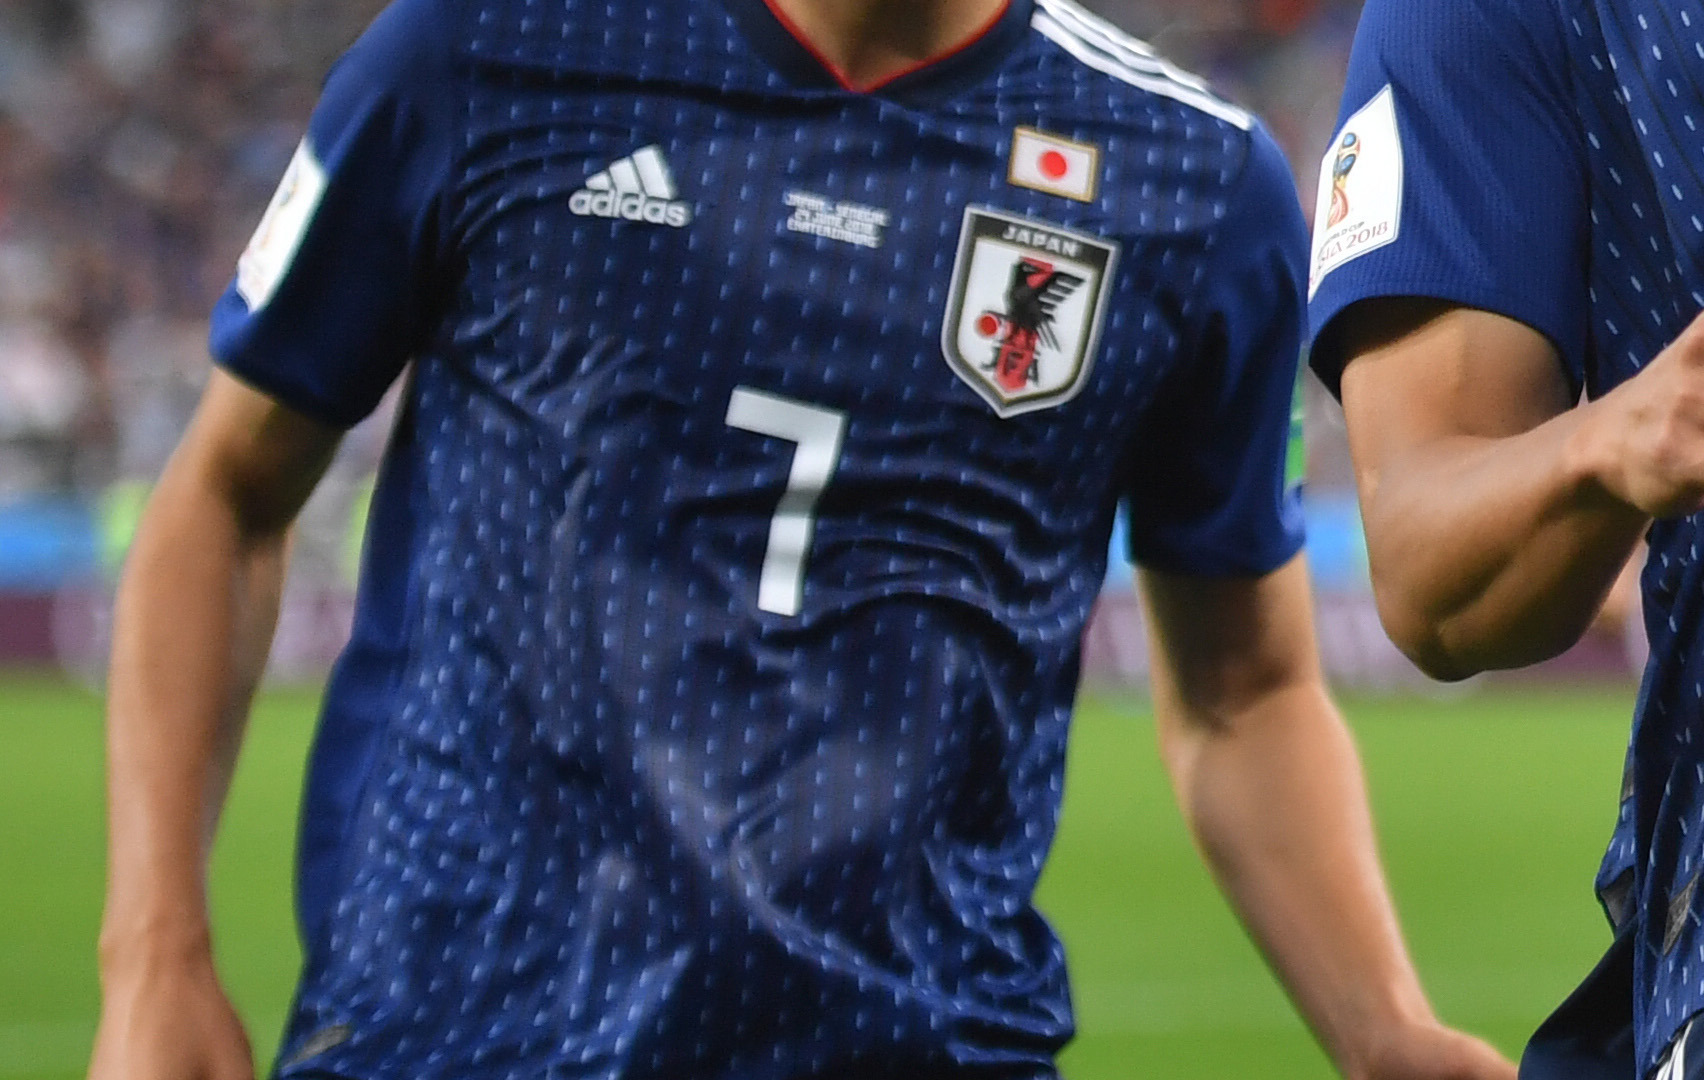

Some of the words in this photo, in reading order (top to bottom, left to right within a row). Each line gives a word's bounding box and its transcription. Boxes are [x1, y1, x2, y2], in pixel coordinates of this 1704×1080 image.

[568, 187, 690, 228] adidas
[1002, 225, 1079, 258] JAPAN
[1346, 221, 1388, 249] 2018
[981, 346, 1040, 387] JFA
[725, 384, 846, 617] 7
